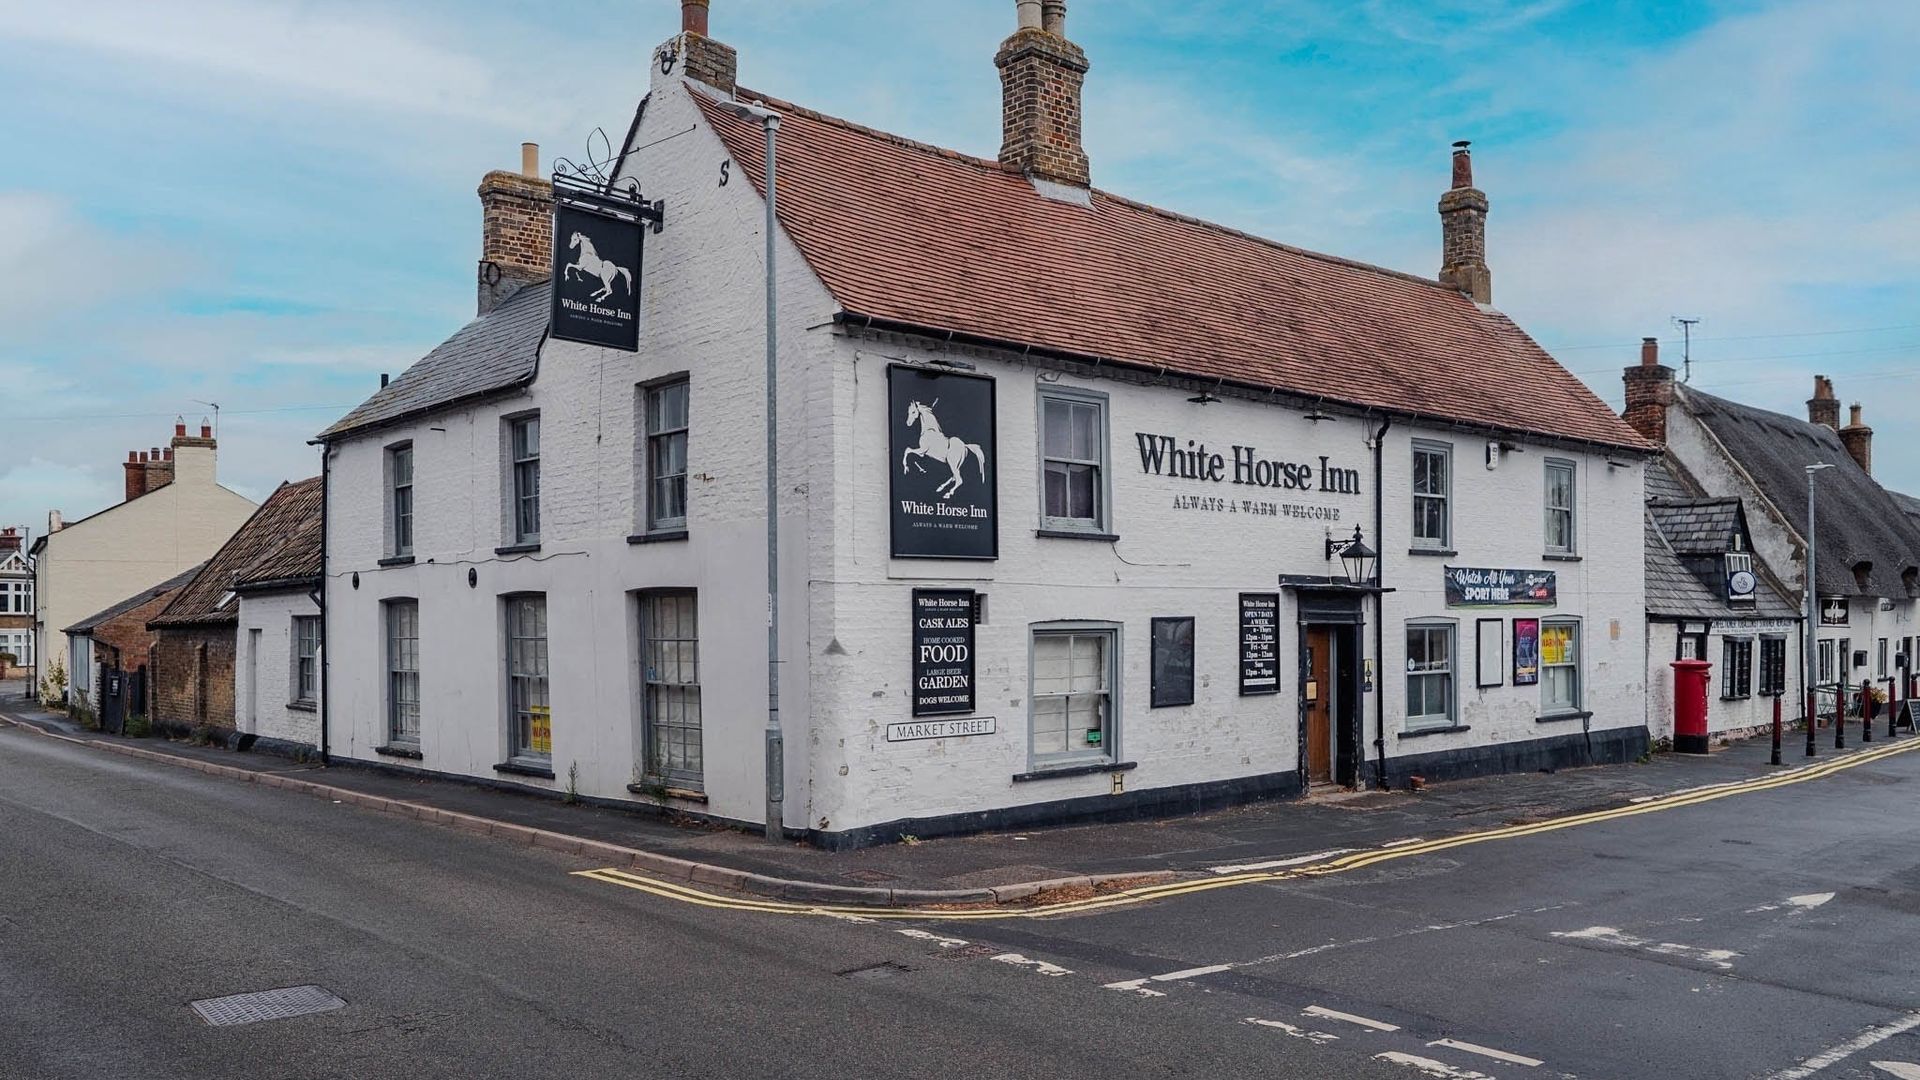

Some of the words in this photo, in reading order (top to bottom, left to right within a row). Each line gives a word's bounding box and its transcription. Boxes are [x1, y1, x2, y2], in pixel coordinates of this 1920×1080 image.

[562, 298, 587, 311] White
[590, 303, 616, 316] Horse
[617, 309, 632, 320] Inn
[1135, 432, 1225, 482] White
[1232, 445, 1312, 491] Horse
[1319, 455, 1361, 495] Inn
[901, 500, 934, 515] White
[936, 502, 968, 517] Horse
[970, 504, 988, 518] Inn
[1173, 495, 1224, 512] ALWAYS
[1229, 502, 1237, 513] A
[1242, 500, 1277, 517] WARM
[1282, 503, 1341, 521] WELCOME
[1456, 569, 1482, 585] Watch
[1484, 569, 1498, 587] All
[1499, 570, 1515, 588] Your
[918, 598, 938, 607] White
[939, 598, 958, 607] Horse
[958, 598, 970, 607] Inn
[1465, 587, 1490, 600] SPORT
[1491, 587, 1509, 600] HERE
[919, 618, 944, 628] CASK
[945, 618, 969, 628] ALES
[920, 644, 968, 663] FOOD
[926, 668, 946, 676] LARGE
[919, 675, 969, 690] GARDEN
[919, 696, 937, 705] DOGS
[938, 695, 969, 704] WELCOME
[896, 723, 945, 738] MARKET
[949, 720, 990, 734] STREET
